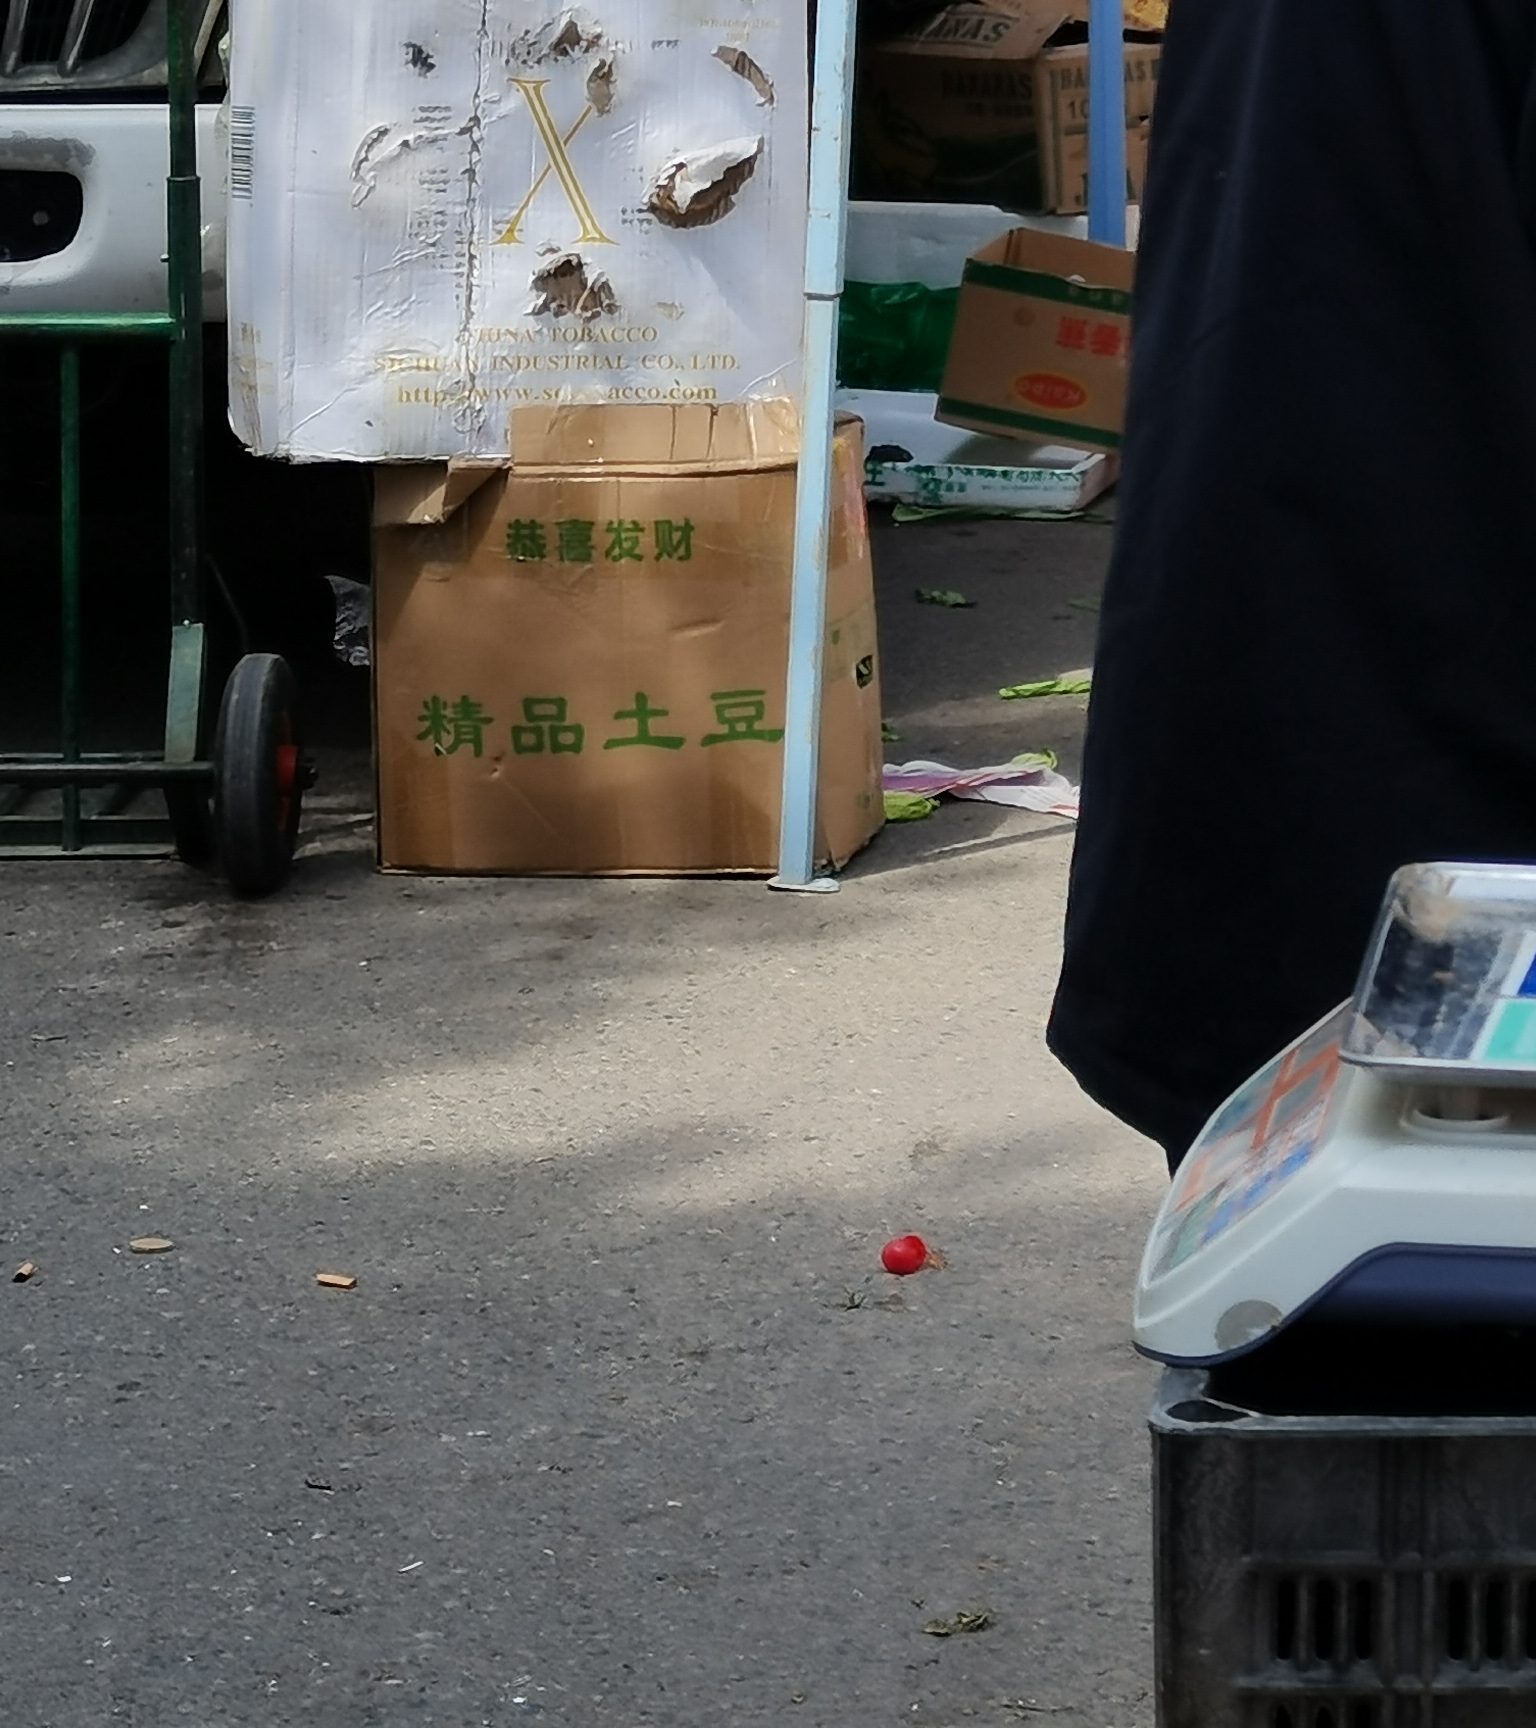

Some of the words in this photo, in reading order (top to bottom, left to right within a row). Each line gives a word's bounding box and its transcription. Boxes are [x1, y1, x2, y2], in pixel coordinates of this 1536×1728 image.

[550, 326, 659, 344] TOBACCO
[490, 353, 629, 371] INDUSTRIAL
[506, 517, 696, 562] 恭喜发财
[416, 689, 786, 758] 精品土豆
